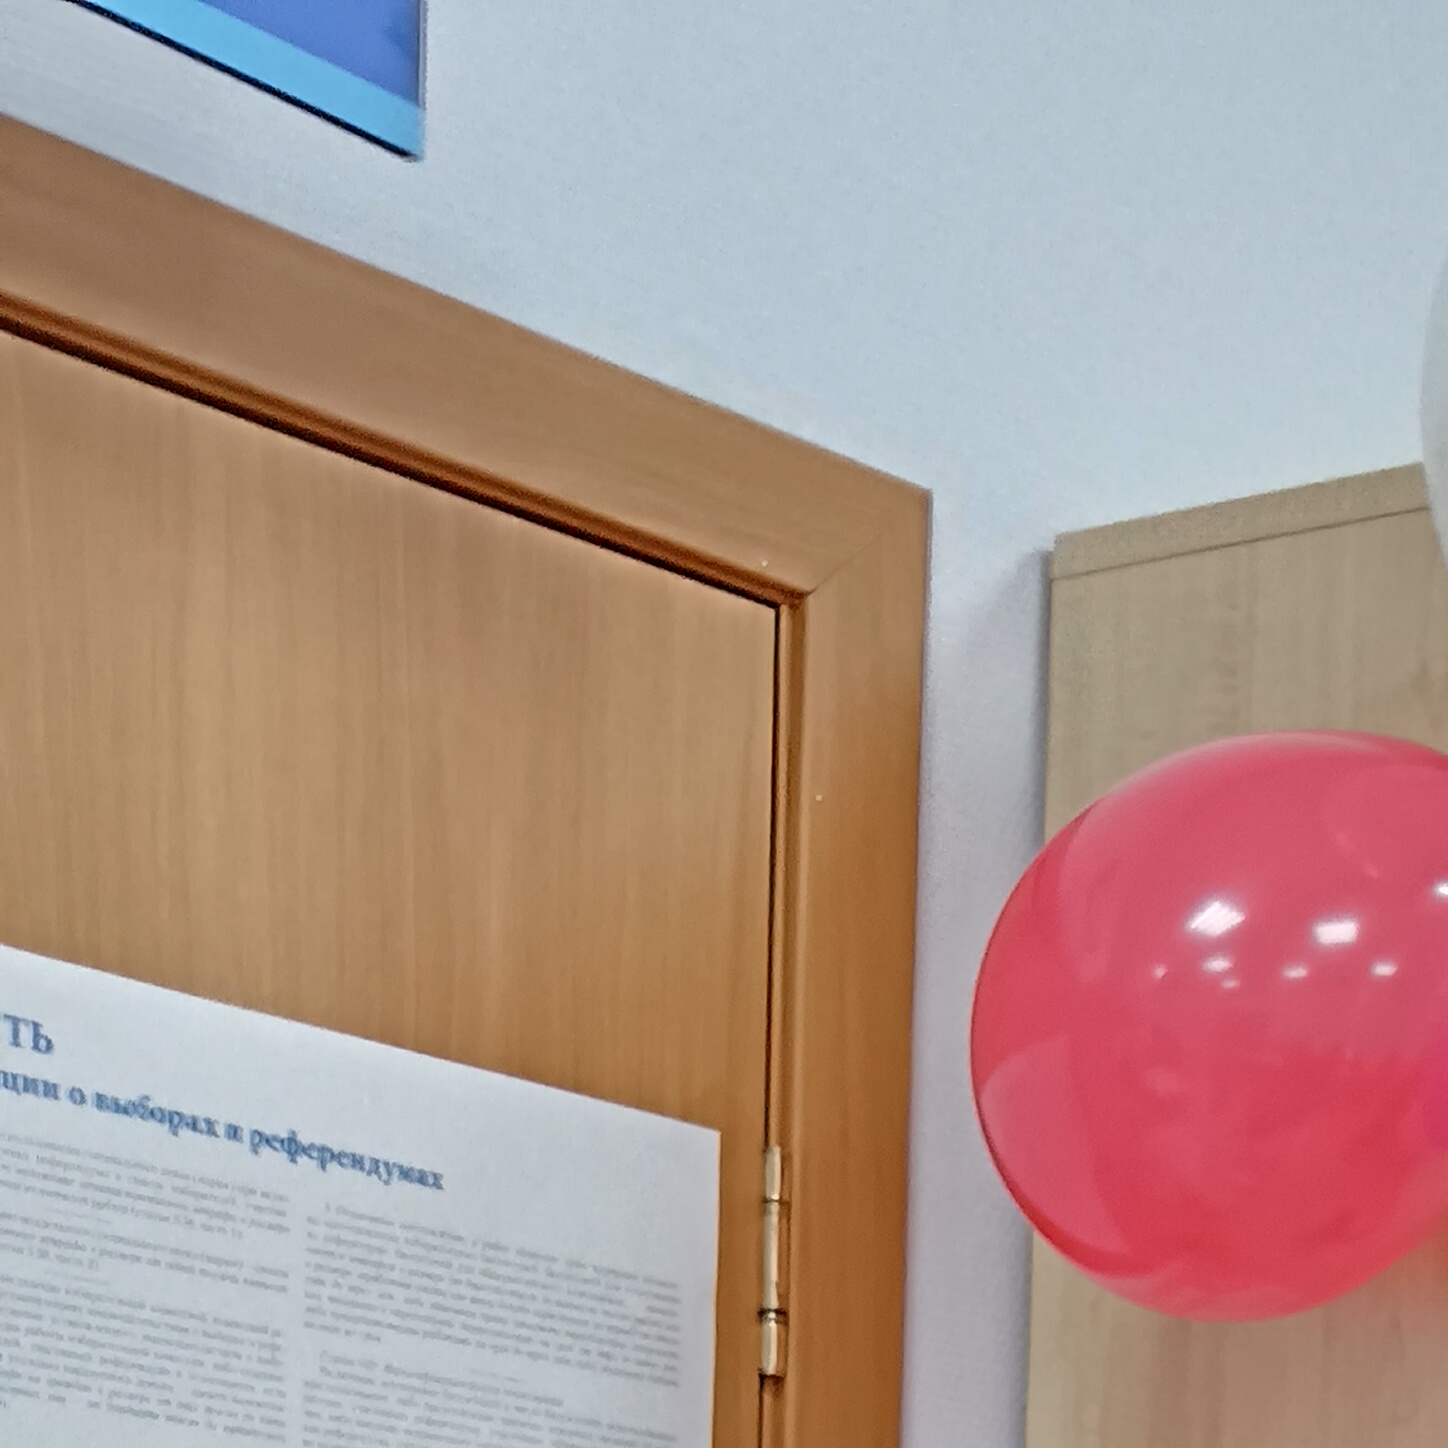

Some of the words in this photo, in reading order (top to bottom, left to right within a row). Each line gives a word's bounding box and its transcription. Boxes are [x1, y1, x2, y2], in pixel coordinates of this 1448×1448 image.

[3, 1013, 54, 1055] ТЬ
[66, 1085, 88, 1106] о
[94, 1091, 220, 1137] выборах
[223, 1121, 244, 1143] и
[248, 1129, 445, 1191] референдумах
